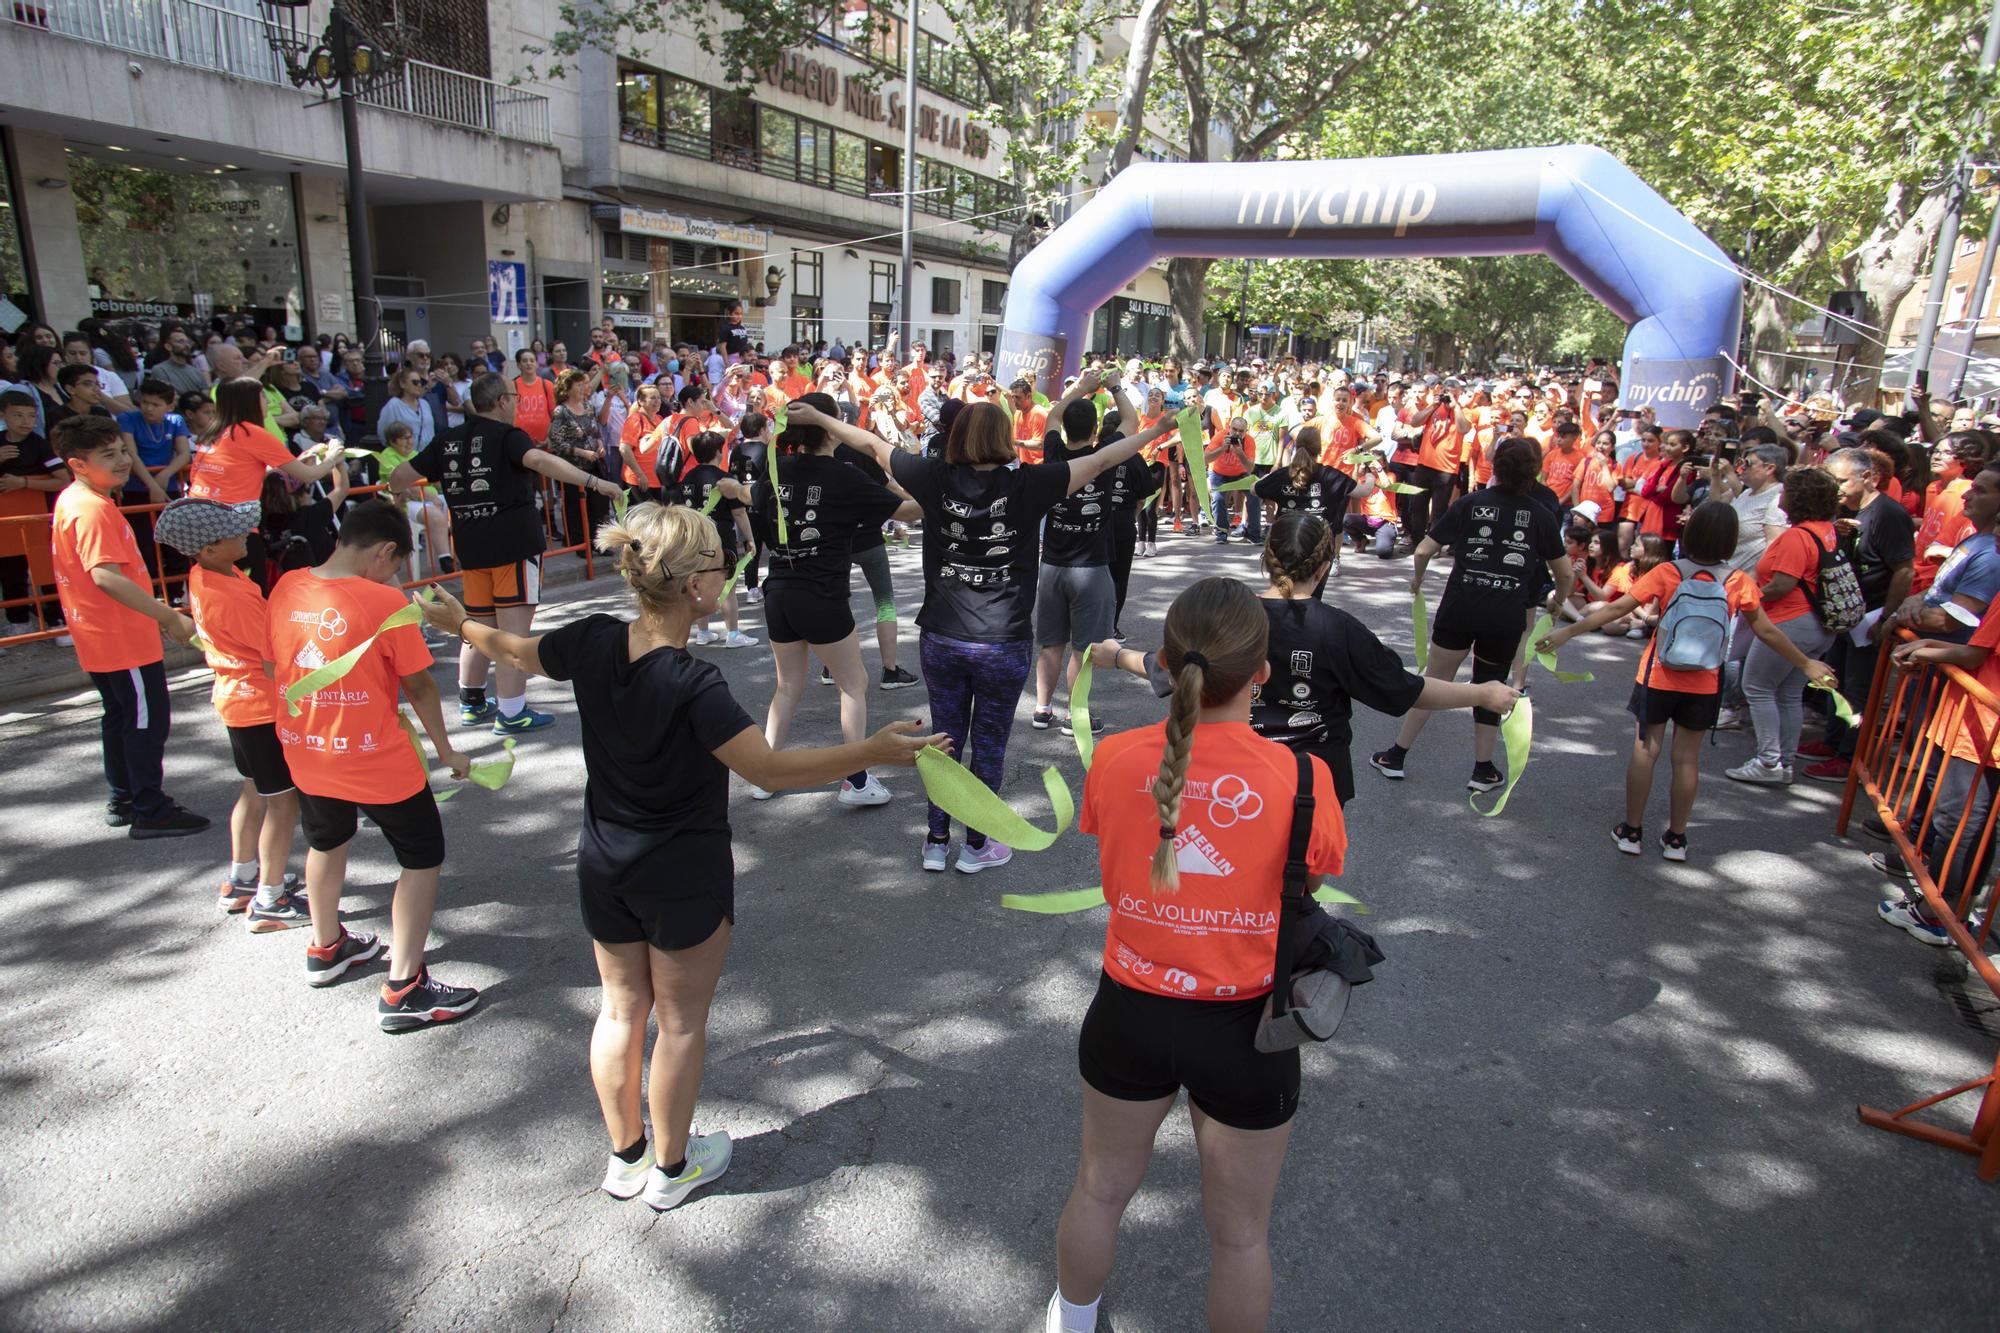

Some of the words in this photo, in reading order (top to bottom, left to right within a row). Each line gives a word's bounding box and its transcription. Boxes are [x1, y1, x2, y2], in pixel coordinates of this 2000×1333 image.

[942, 114, 961, 149] LA
[1237, 178, 1437, 237] mychip
[1628, 380, 1707, 406] mychip
[1185, 824, 1236, 876] MERLIN
[1153, 902, 1276, 928] VOLUNTÀRIA
